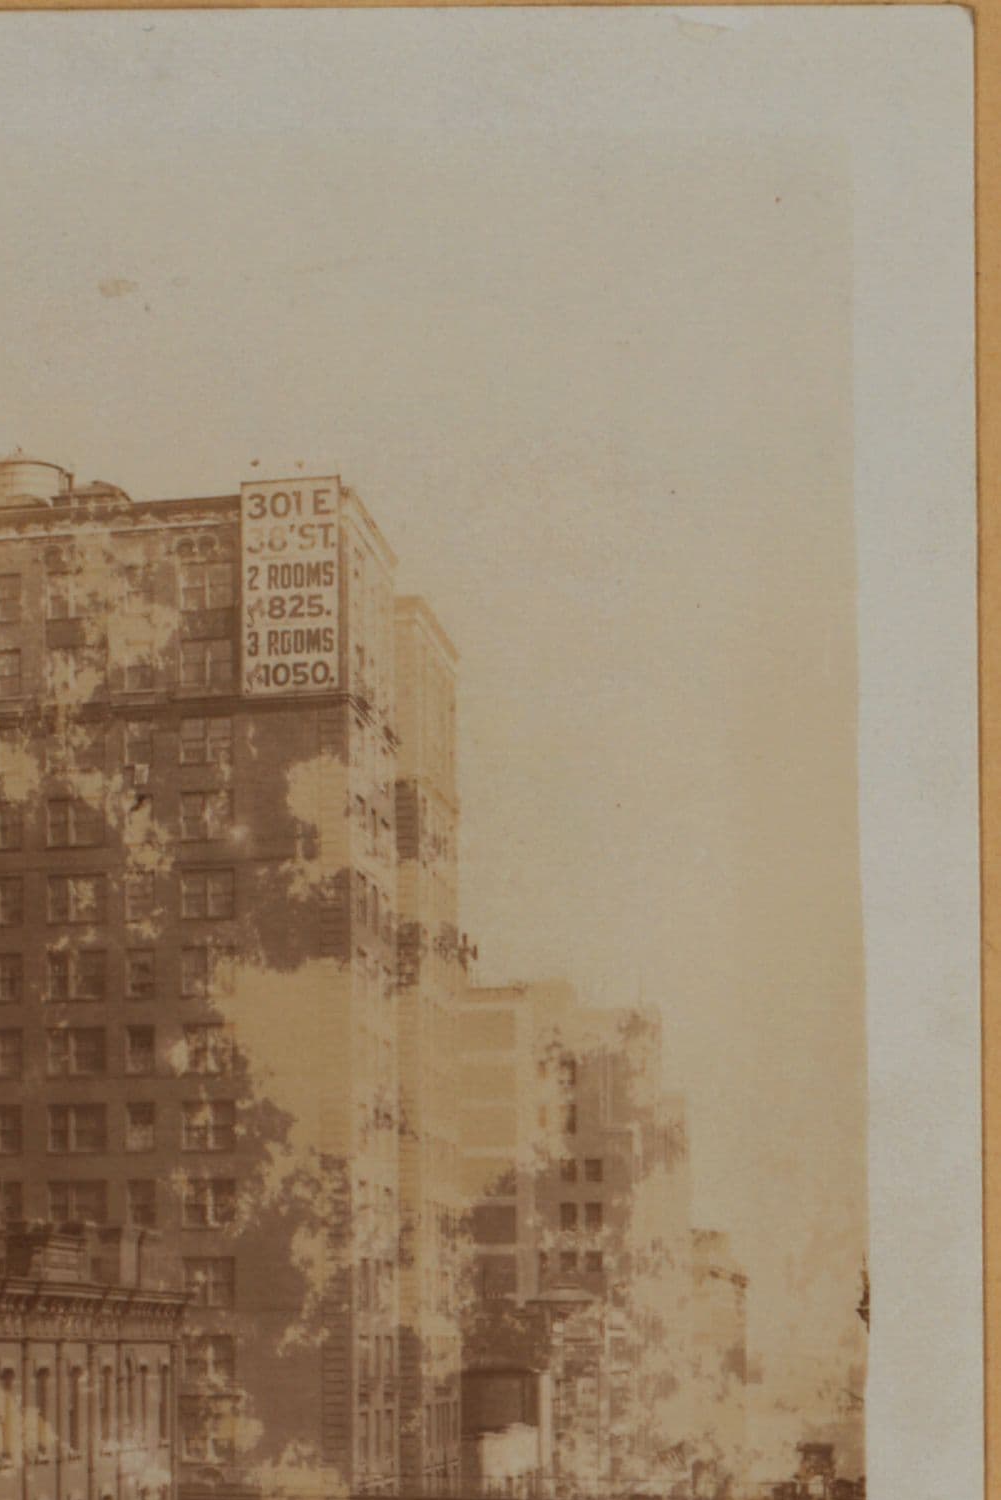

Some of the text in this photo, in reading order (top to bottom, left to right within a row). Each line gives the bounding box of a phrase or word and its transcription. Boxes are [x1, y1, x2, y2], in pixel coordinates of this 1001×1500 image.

[247, 490, 303, 520] 301
[247, 560, 335, 591] 2 ROOMS
[247, 627, 335, 657] 3 ROOMS
